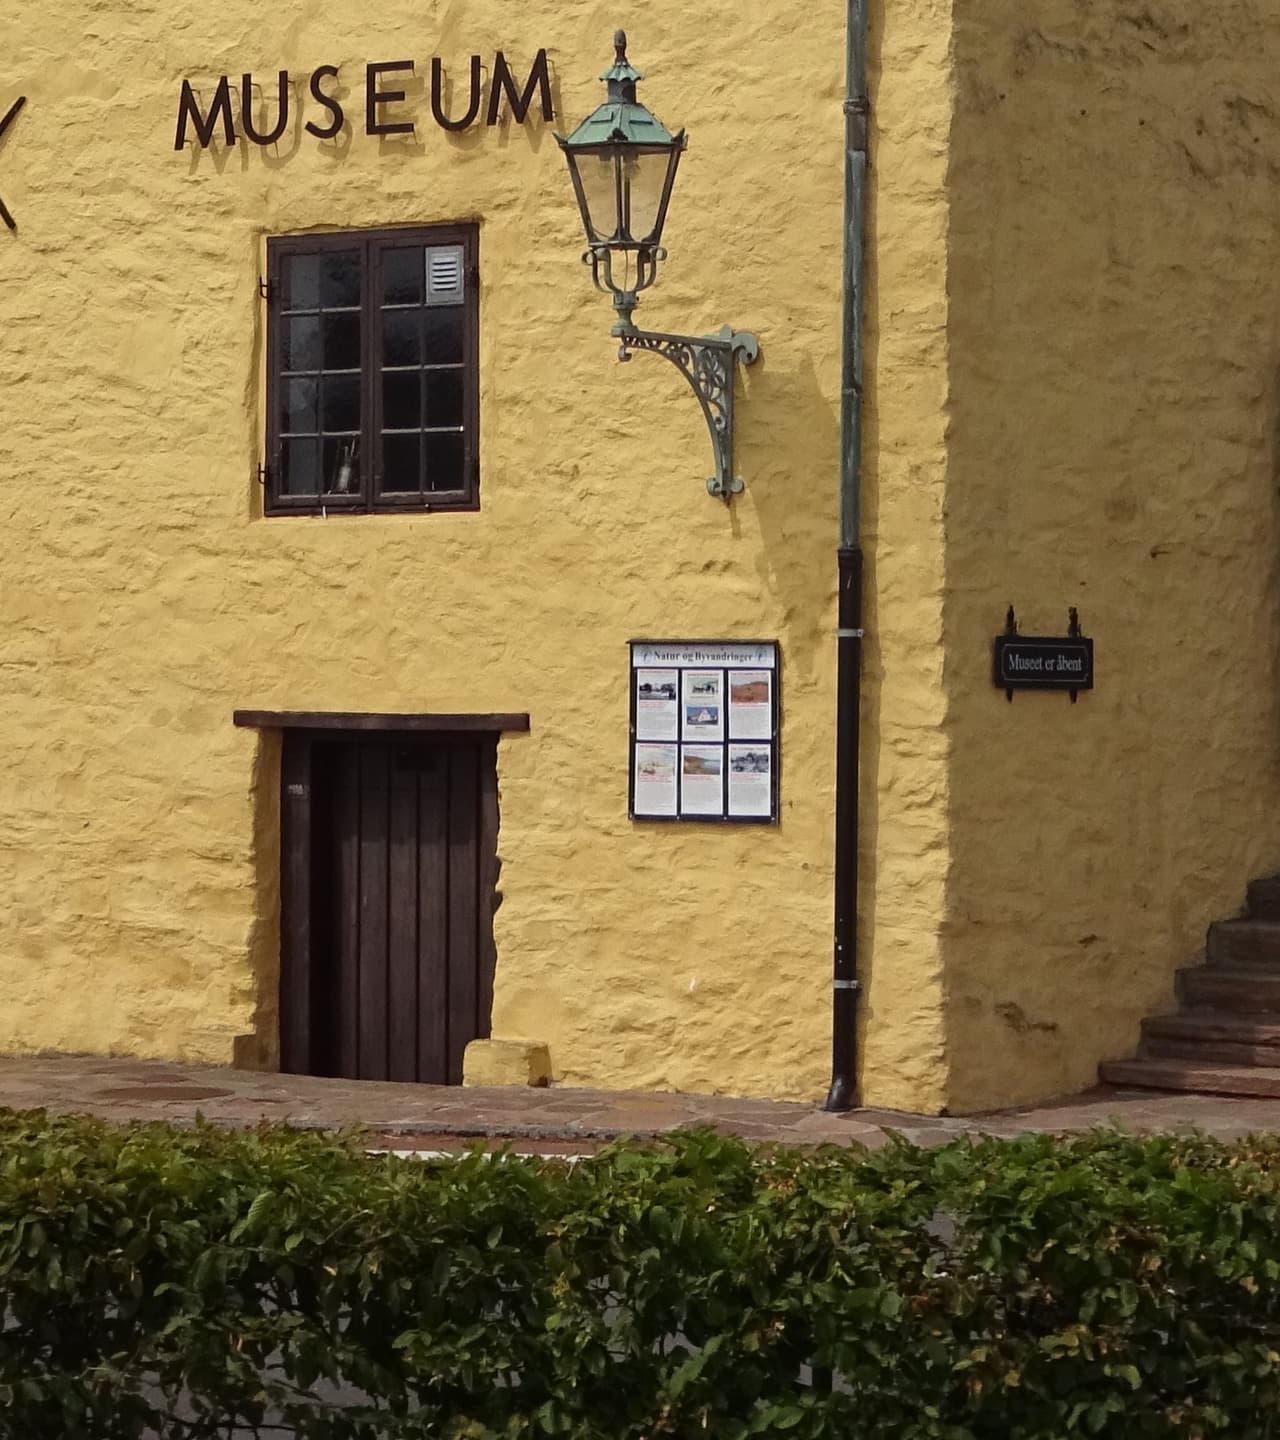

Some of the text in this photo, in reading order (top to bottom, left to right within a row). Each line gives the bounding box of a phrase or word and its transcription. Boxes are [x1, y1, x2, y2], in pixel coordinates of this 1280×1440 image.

[173, 47, 555, 152] MUSEUM
[654, 650, 753, 663] Natur og Byvandringer
[1008, 654, 1082, 672] Museet er åbent
